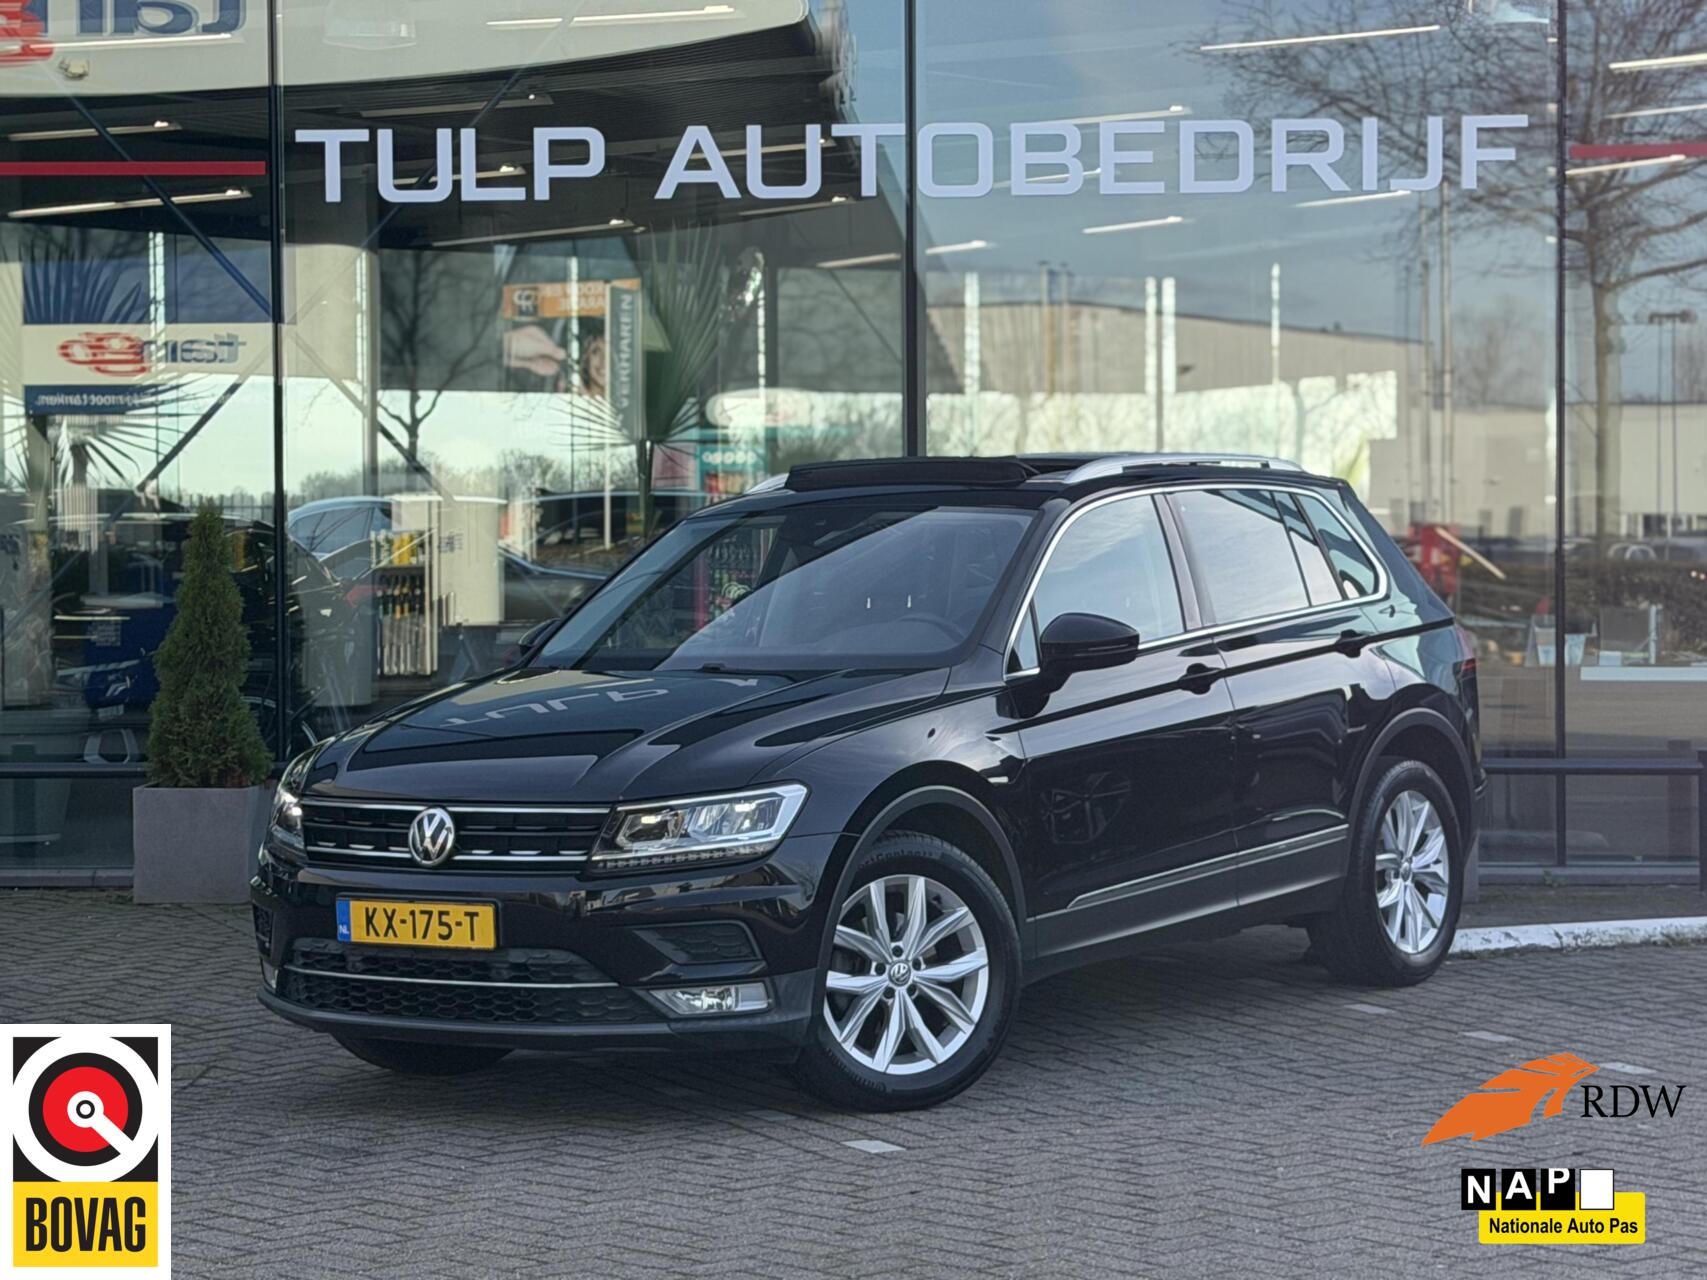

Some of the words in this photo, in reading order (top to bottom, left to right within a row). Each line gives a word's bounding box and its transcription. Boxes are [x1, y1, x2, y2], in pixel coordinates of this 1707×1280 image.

[295, 126, 605, 203] TULP
[654, 114, 1529, 199] AUTOBEDRIJF
[338, 924, 350, 935] NL
[365, 907, 480, 942] KX-175-T
